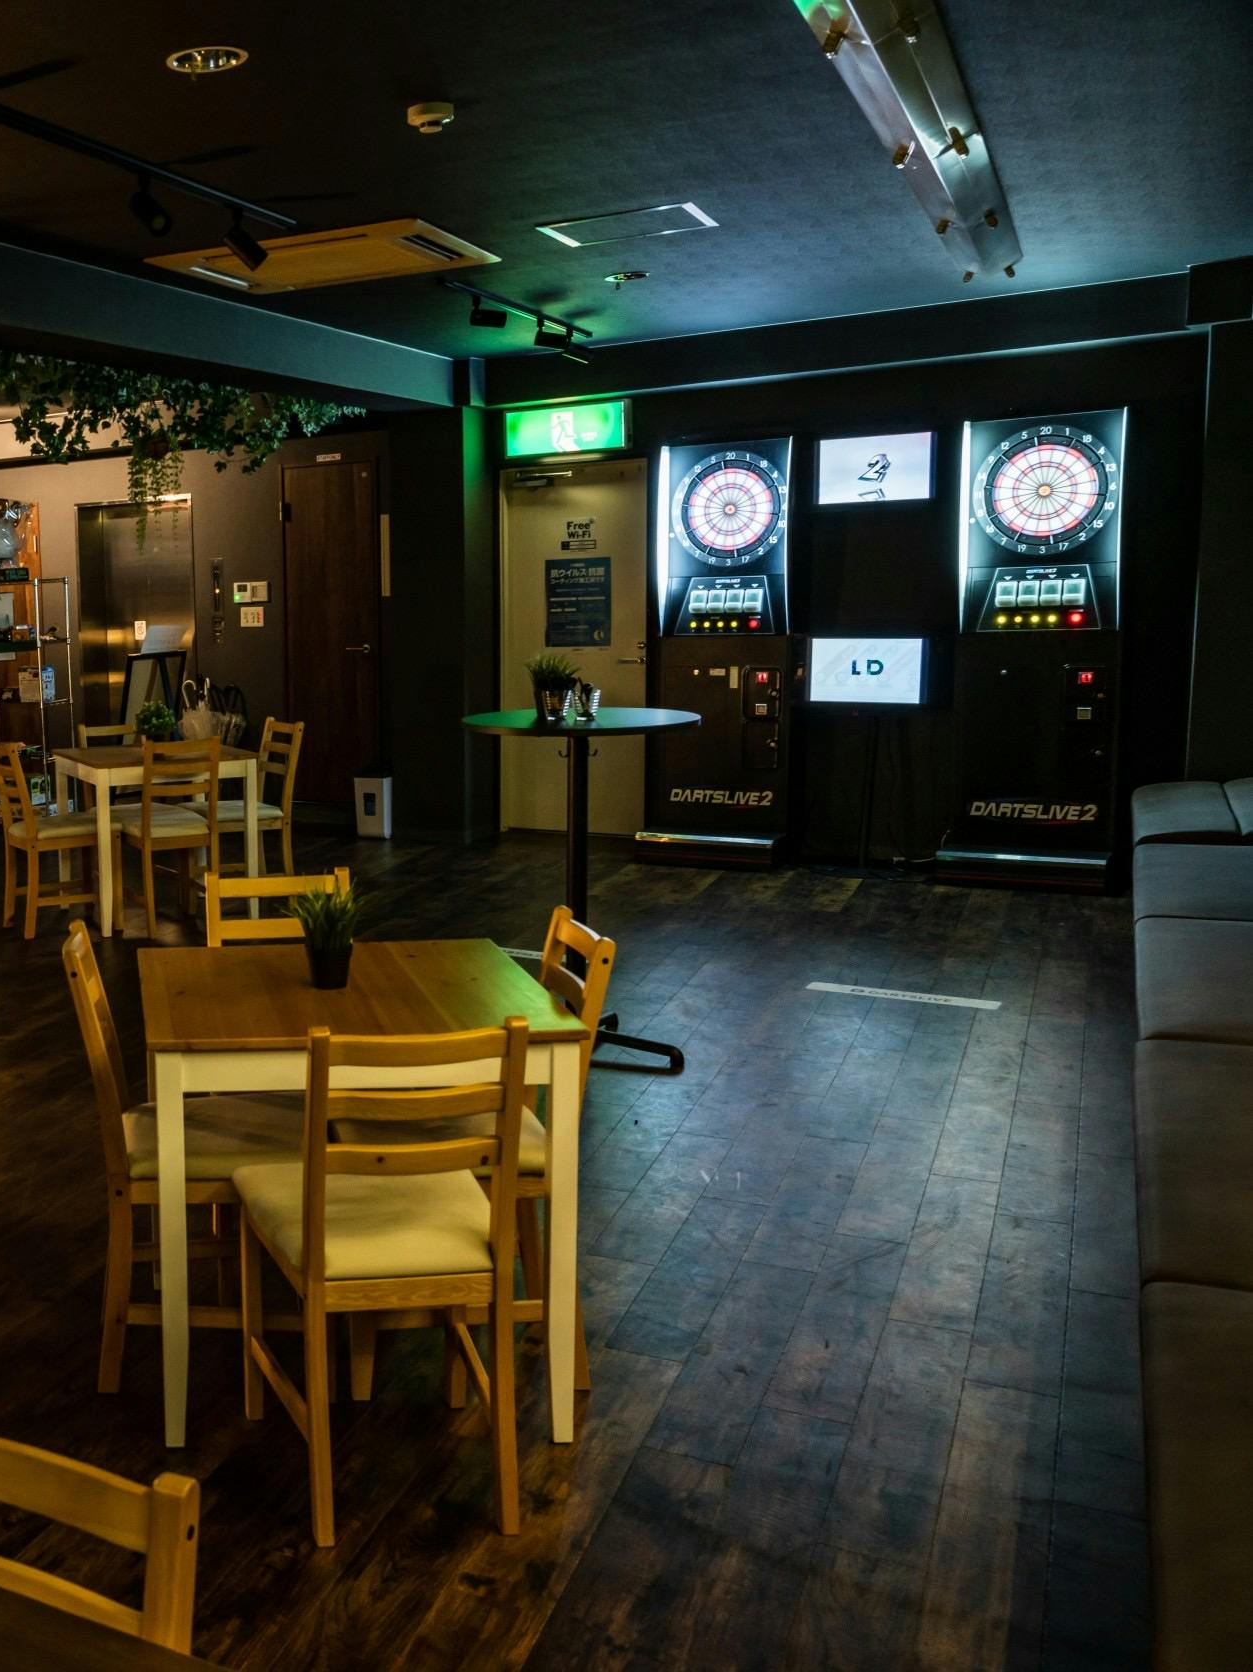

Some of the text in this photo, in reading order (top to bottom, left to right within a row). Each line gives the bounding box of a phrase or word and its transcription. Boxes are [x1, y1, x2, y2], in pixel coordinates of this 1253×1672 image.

[1021, 431, 1028, 439] 5
[1040, 426, 1052, 435] 20
[1065, 427, 1070, 436] 1
[1082, 434, 1092, 443] 18
[1001, 442, 1010, 450] 12
[1098, 446, 1106, 455] 4
[858, 453, 891, 482] 2
[1106, 463, 1116, 472] 13
[1109, 482, 1116, 490] 6
[1104, 501, 1114, 511] 10
[566, 521, 591, 530] Free
[1093, 519, 1104, 529] 15
[567, 530, 591, 539] Wi-Fi
[1079, 533, 1087, 541] 2
[1001, 538, 1008, 546] 7
[1017, 544, 1026, 552] 19
[1039, 546, 1045, 554] 3
[1058, 543, 1069, 551] 17
[669, 788, 774, 806] DARTSLIVE2
[969, 801, 1099, 821] DARTSLIVE2
